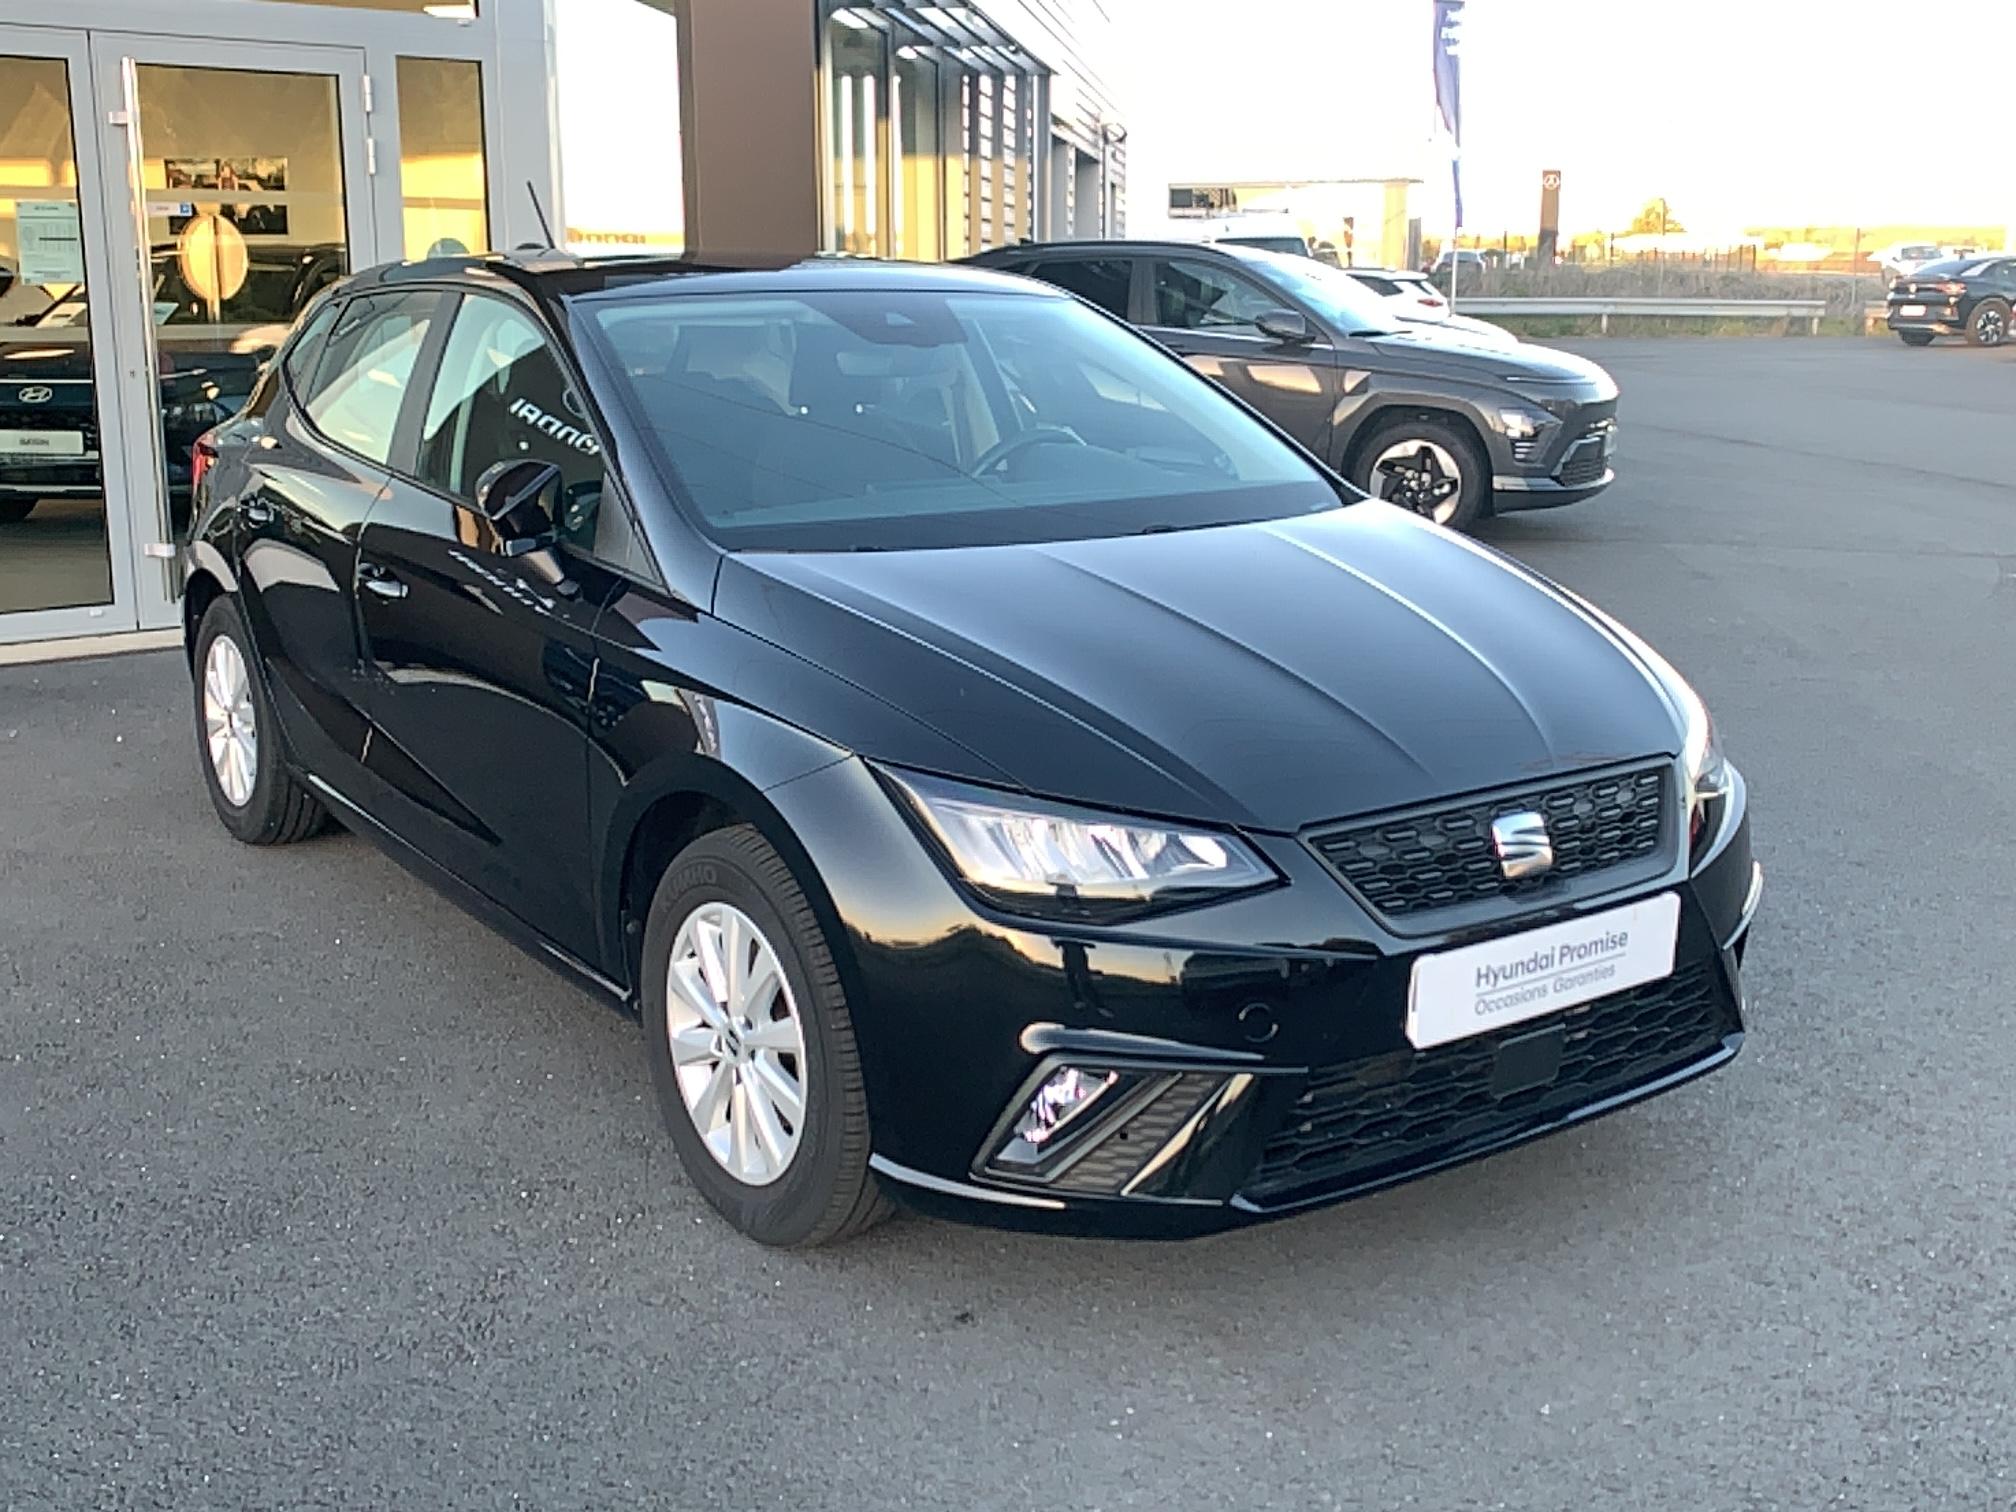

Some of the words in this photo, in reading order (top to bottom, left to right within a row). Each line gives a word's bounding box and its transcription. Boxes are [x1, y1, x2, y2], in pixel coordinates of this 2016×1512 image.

[1475, 946, 1555, 988] Hyundai
[1558, 930, 1629, 966] Promise
[1474, 984, 1549, 1016] Occasions
[1552, 964, 1616, 994] Garanties
